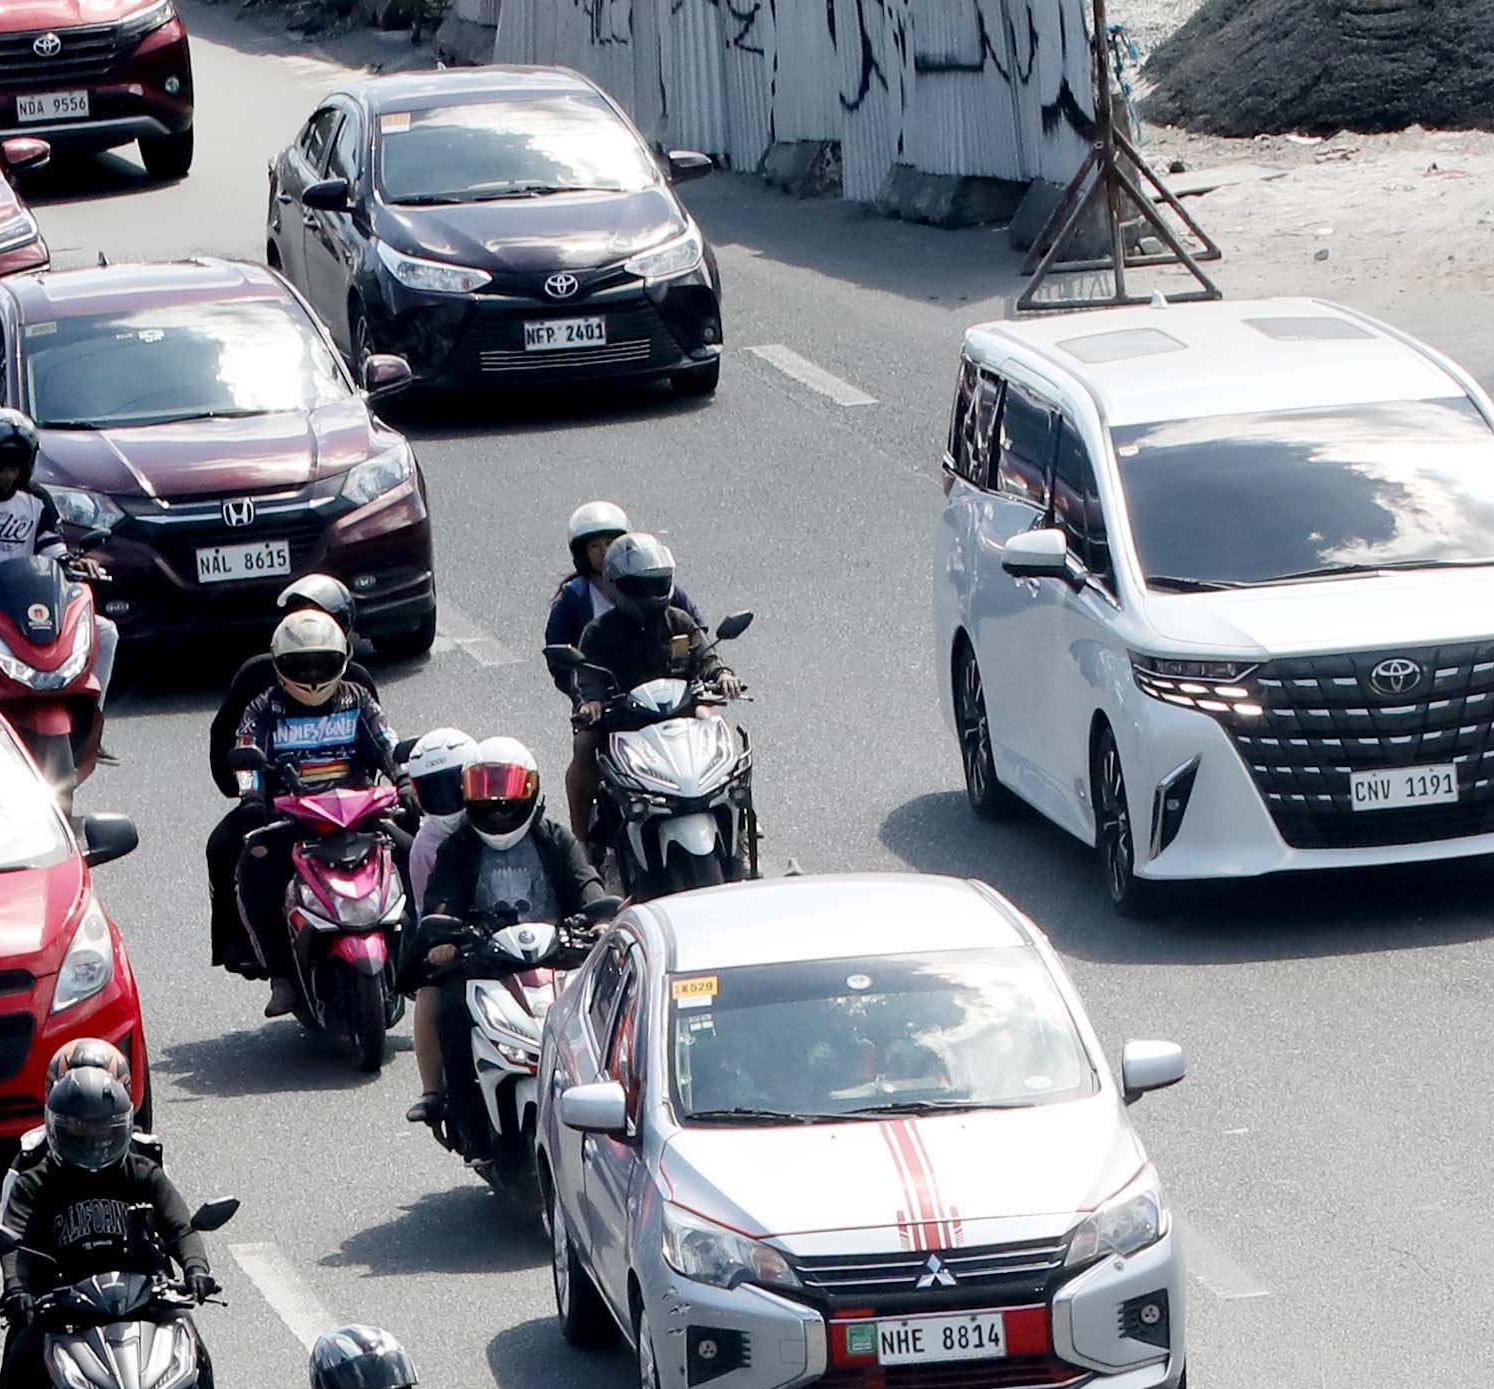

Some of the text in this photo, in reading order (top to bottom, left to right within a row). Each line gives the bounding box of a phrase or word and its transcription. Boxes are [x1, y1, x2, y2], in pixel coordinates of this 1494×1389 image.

[19, 99, 87, 117] NDA 9556
[566, 323, 605, 343] 2401
[200, 548, 287, 578] NAL 8615
[1354, 773, 1455, 802] CNV 1191
[882, 1331, 925, 1356] NHE
[942, 1322, 1000, 1350] 8814
